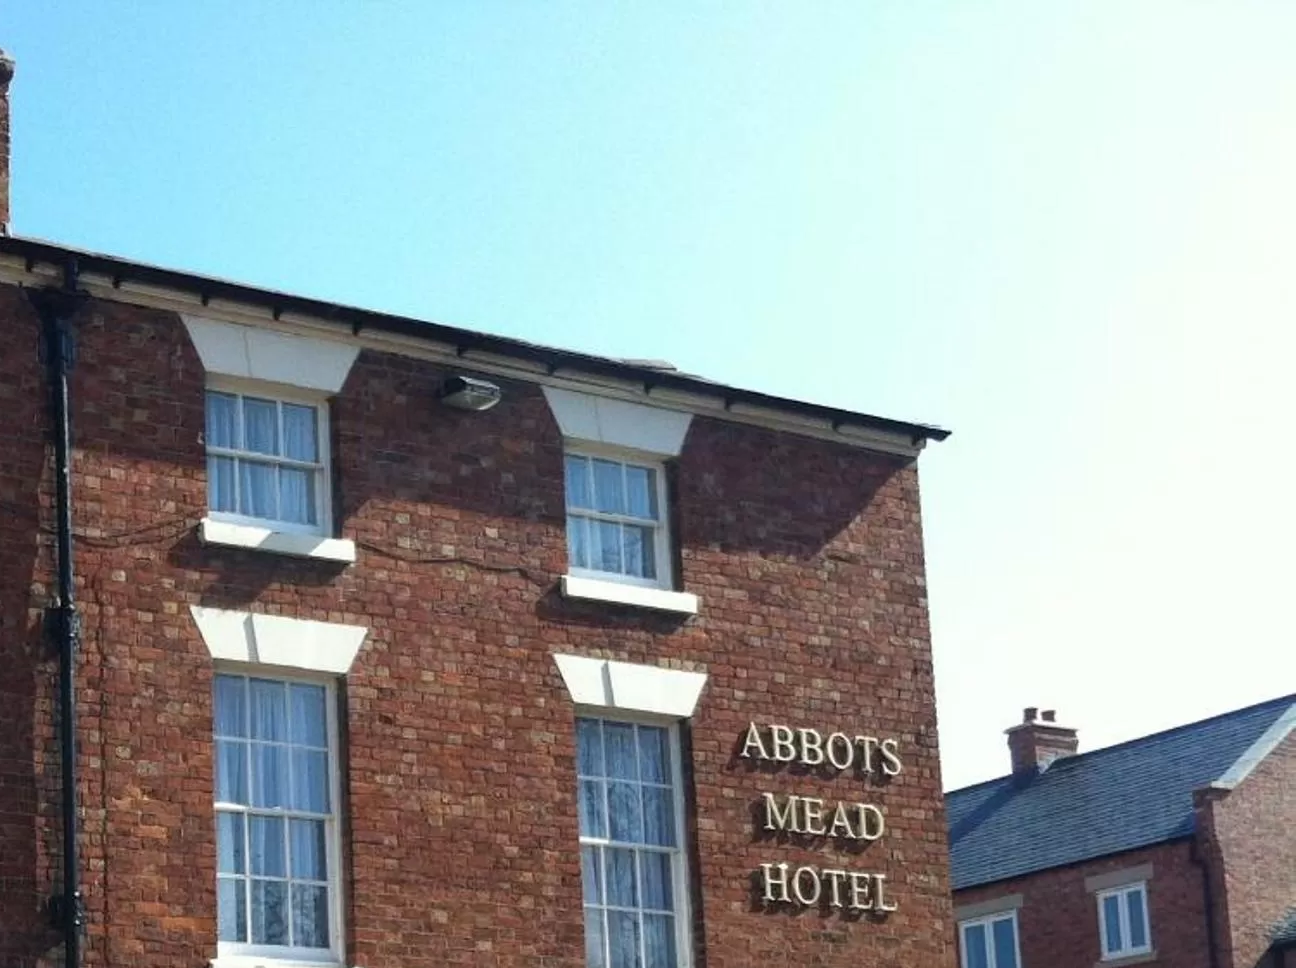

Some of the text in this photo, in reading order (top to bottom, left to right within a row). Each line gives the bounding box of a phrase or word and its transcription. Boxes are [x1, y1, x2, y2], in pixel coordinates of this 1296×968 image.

[740, 721, 902, 775] ABBOTS
[762, 792, 885, 840] MEAD
[759, 863, 898, 911] HOTEL
